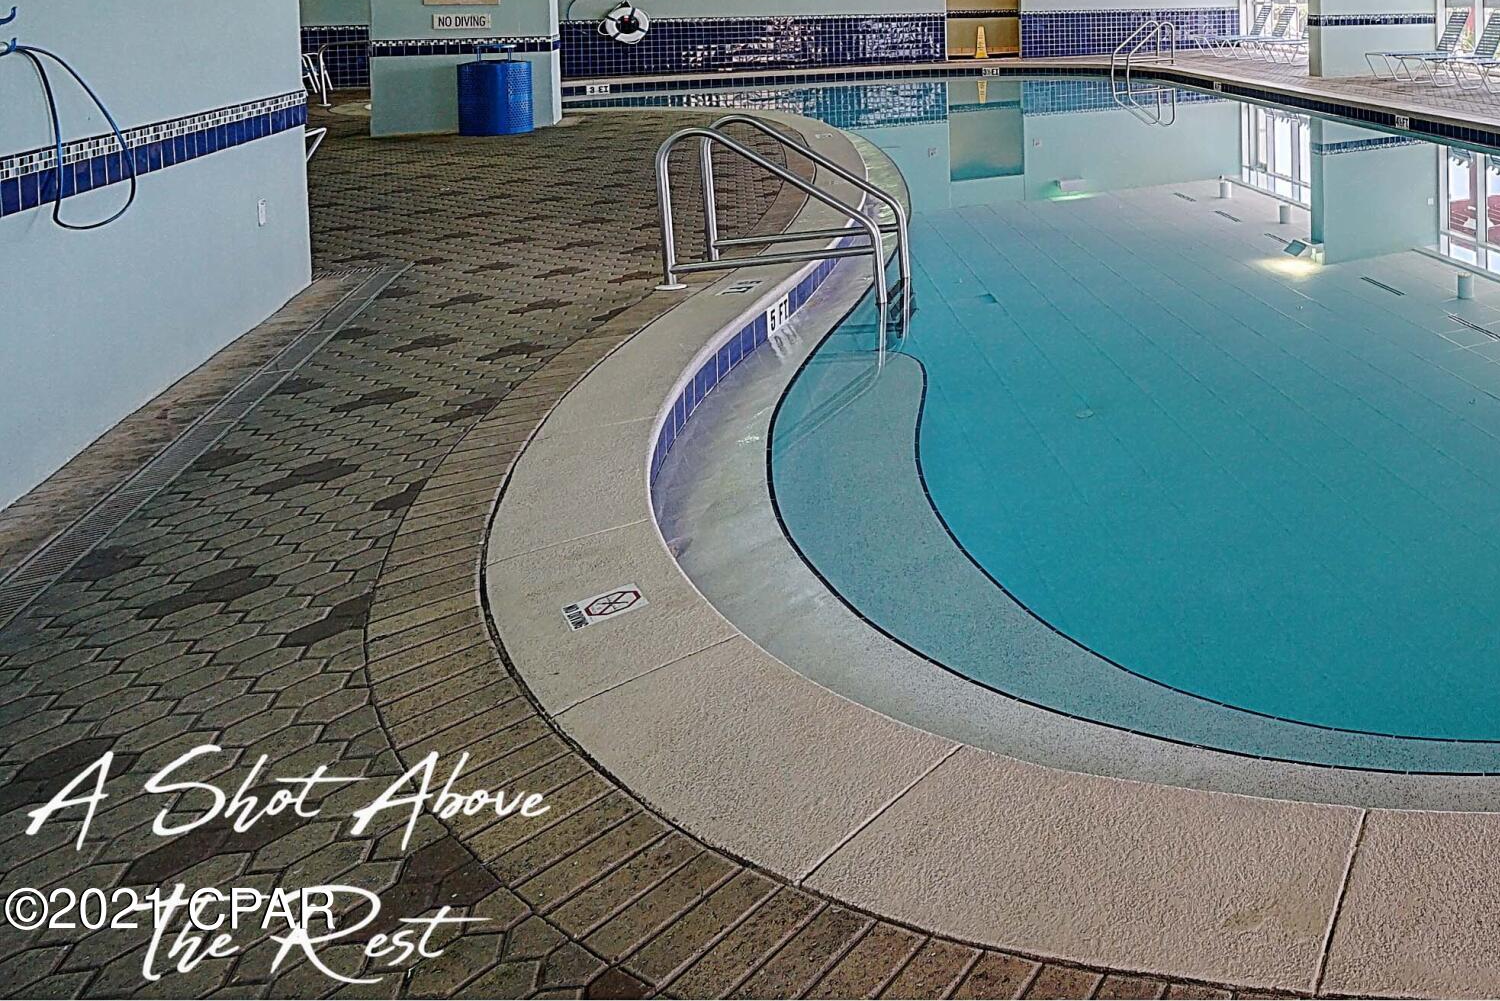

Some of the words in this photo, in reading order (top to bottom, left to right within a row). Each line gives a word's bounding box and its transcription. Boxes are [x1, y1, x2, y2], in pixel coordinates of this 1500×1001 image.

[438, 16, 452, 27] NO
[455, 15, 486, 27] DIVING
[770, 308, 776, 331] 5
